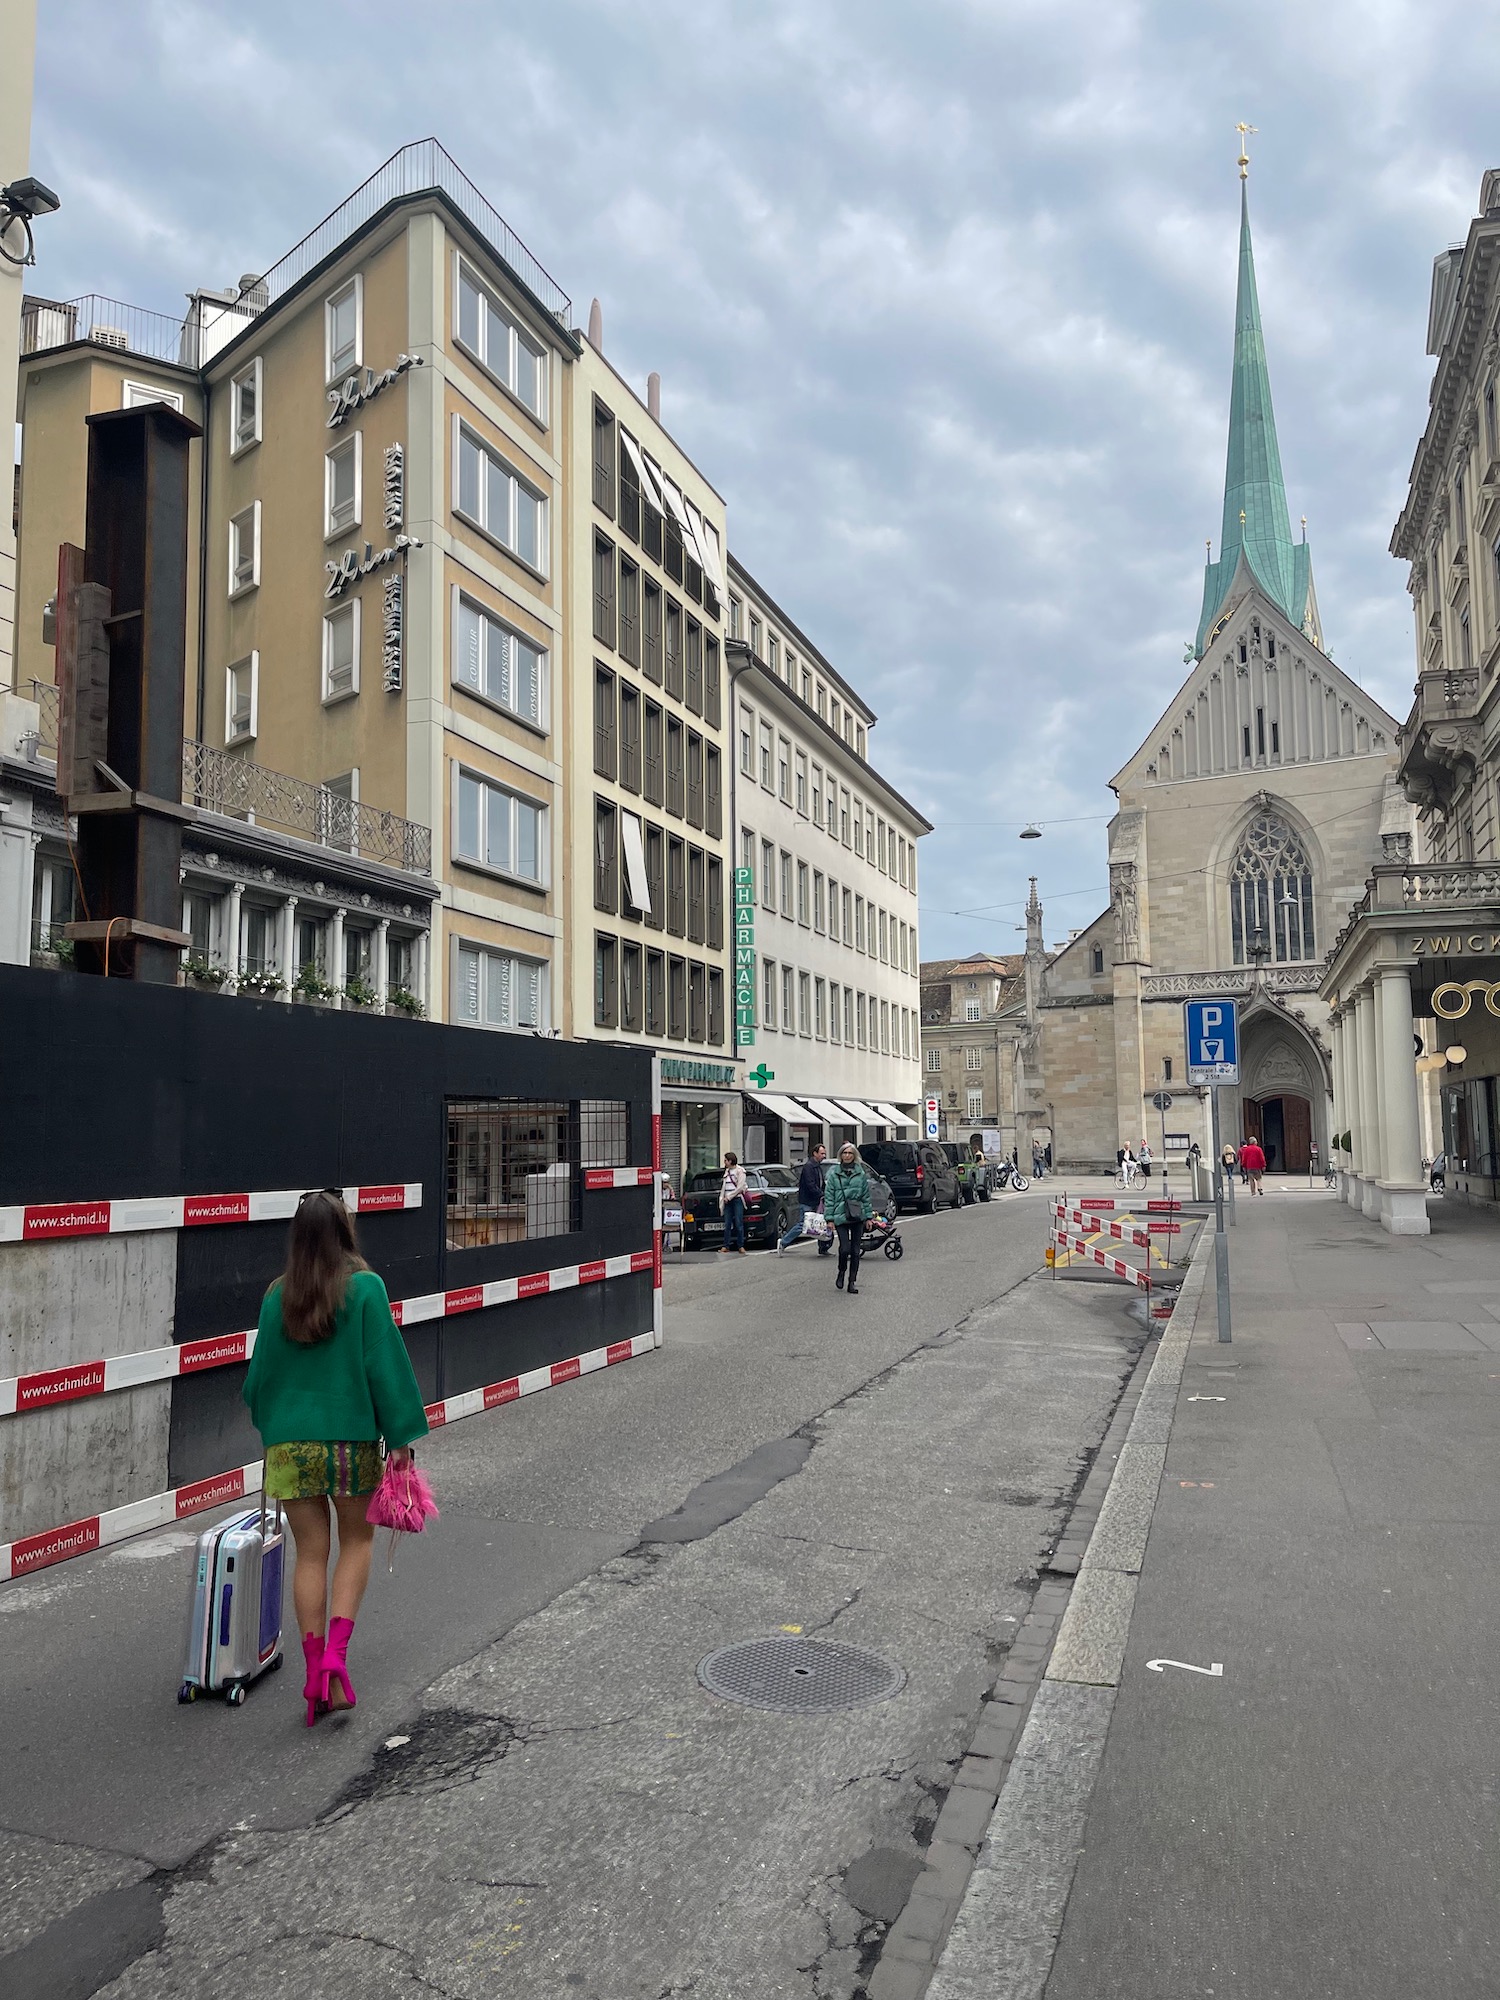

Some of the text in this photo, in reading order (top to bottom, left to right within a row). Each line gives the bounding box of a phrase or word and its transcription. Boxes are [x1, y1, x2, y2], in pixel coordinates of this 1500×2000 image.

[382, 574, 402, 693] PARFUMERIE
[469, 628, 478, 683] COIFFEUR
[501, 635, 509, 701] EXTENSIONS
[530, 664, 538, 718] KOSMETIK
[738, 869, 751, 1045] PHARMACIE
[469, 961, 478, 1016] COIFFEUR
[501, 958, 510, 1026] EXTENSIONS
[530, 972, 538, 1026] KOSMETIK
[1202, 1007, 1222, 1037] P
[187, 1203, 249, 1217] www.schmid.lu
[359, 1193, 404, 1205] www.schmid.lu
[28, 1211, 108, 1229] www.schmid.lu
[446, 1293, 482, 1308] www.schmid.lu
[183, 1342, 245, 1365] www.schmid.lu
[22, 1372, 102, 1399] www.schmid.lu
[485, 1384, 518, 1402] www.schmid.lu
[178, 1479, 242, 1510] www.schmid.lu
[15, 1528, 96, 1565] www.schmid.lu
